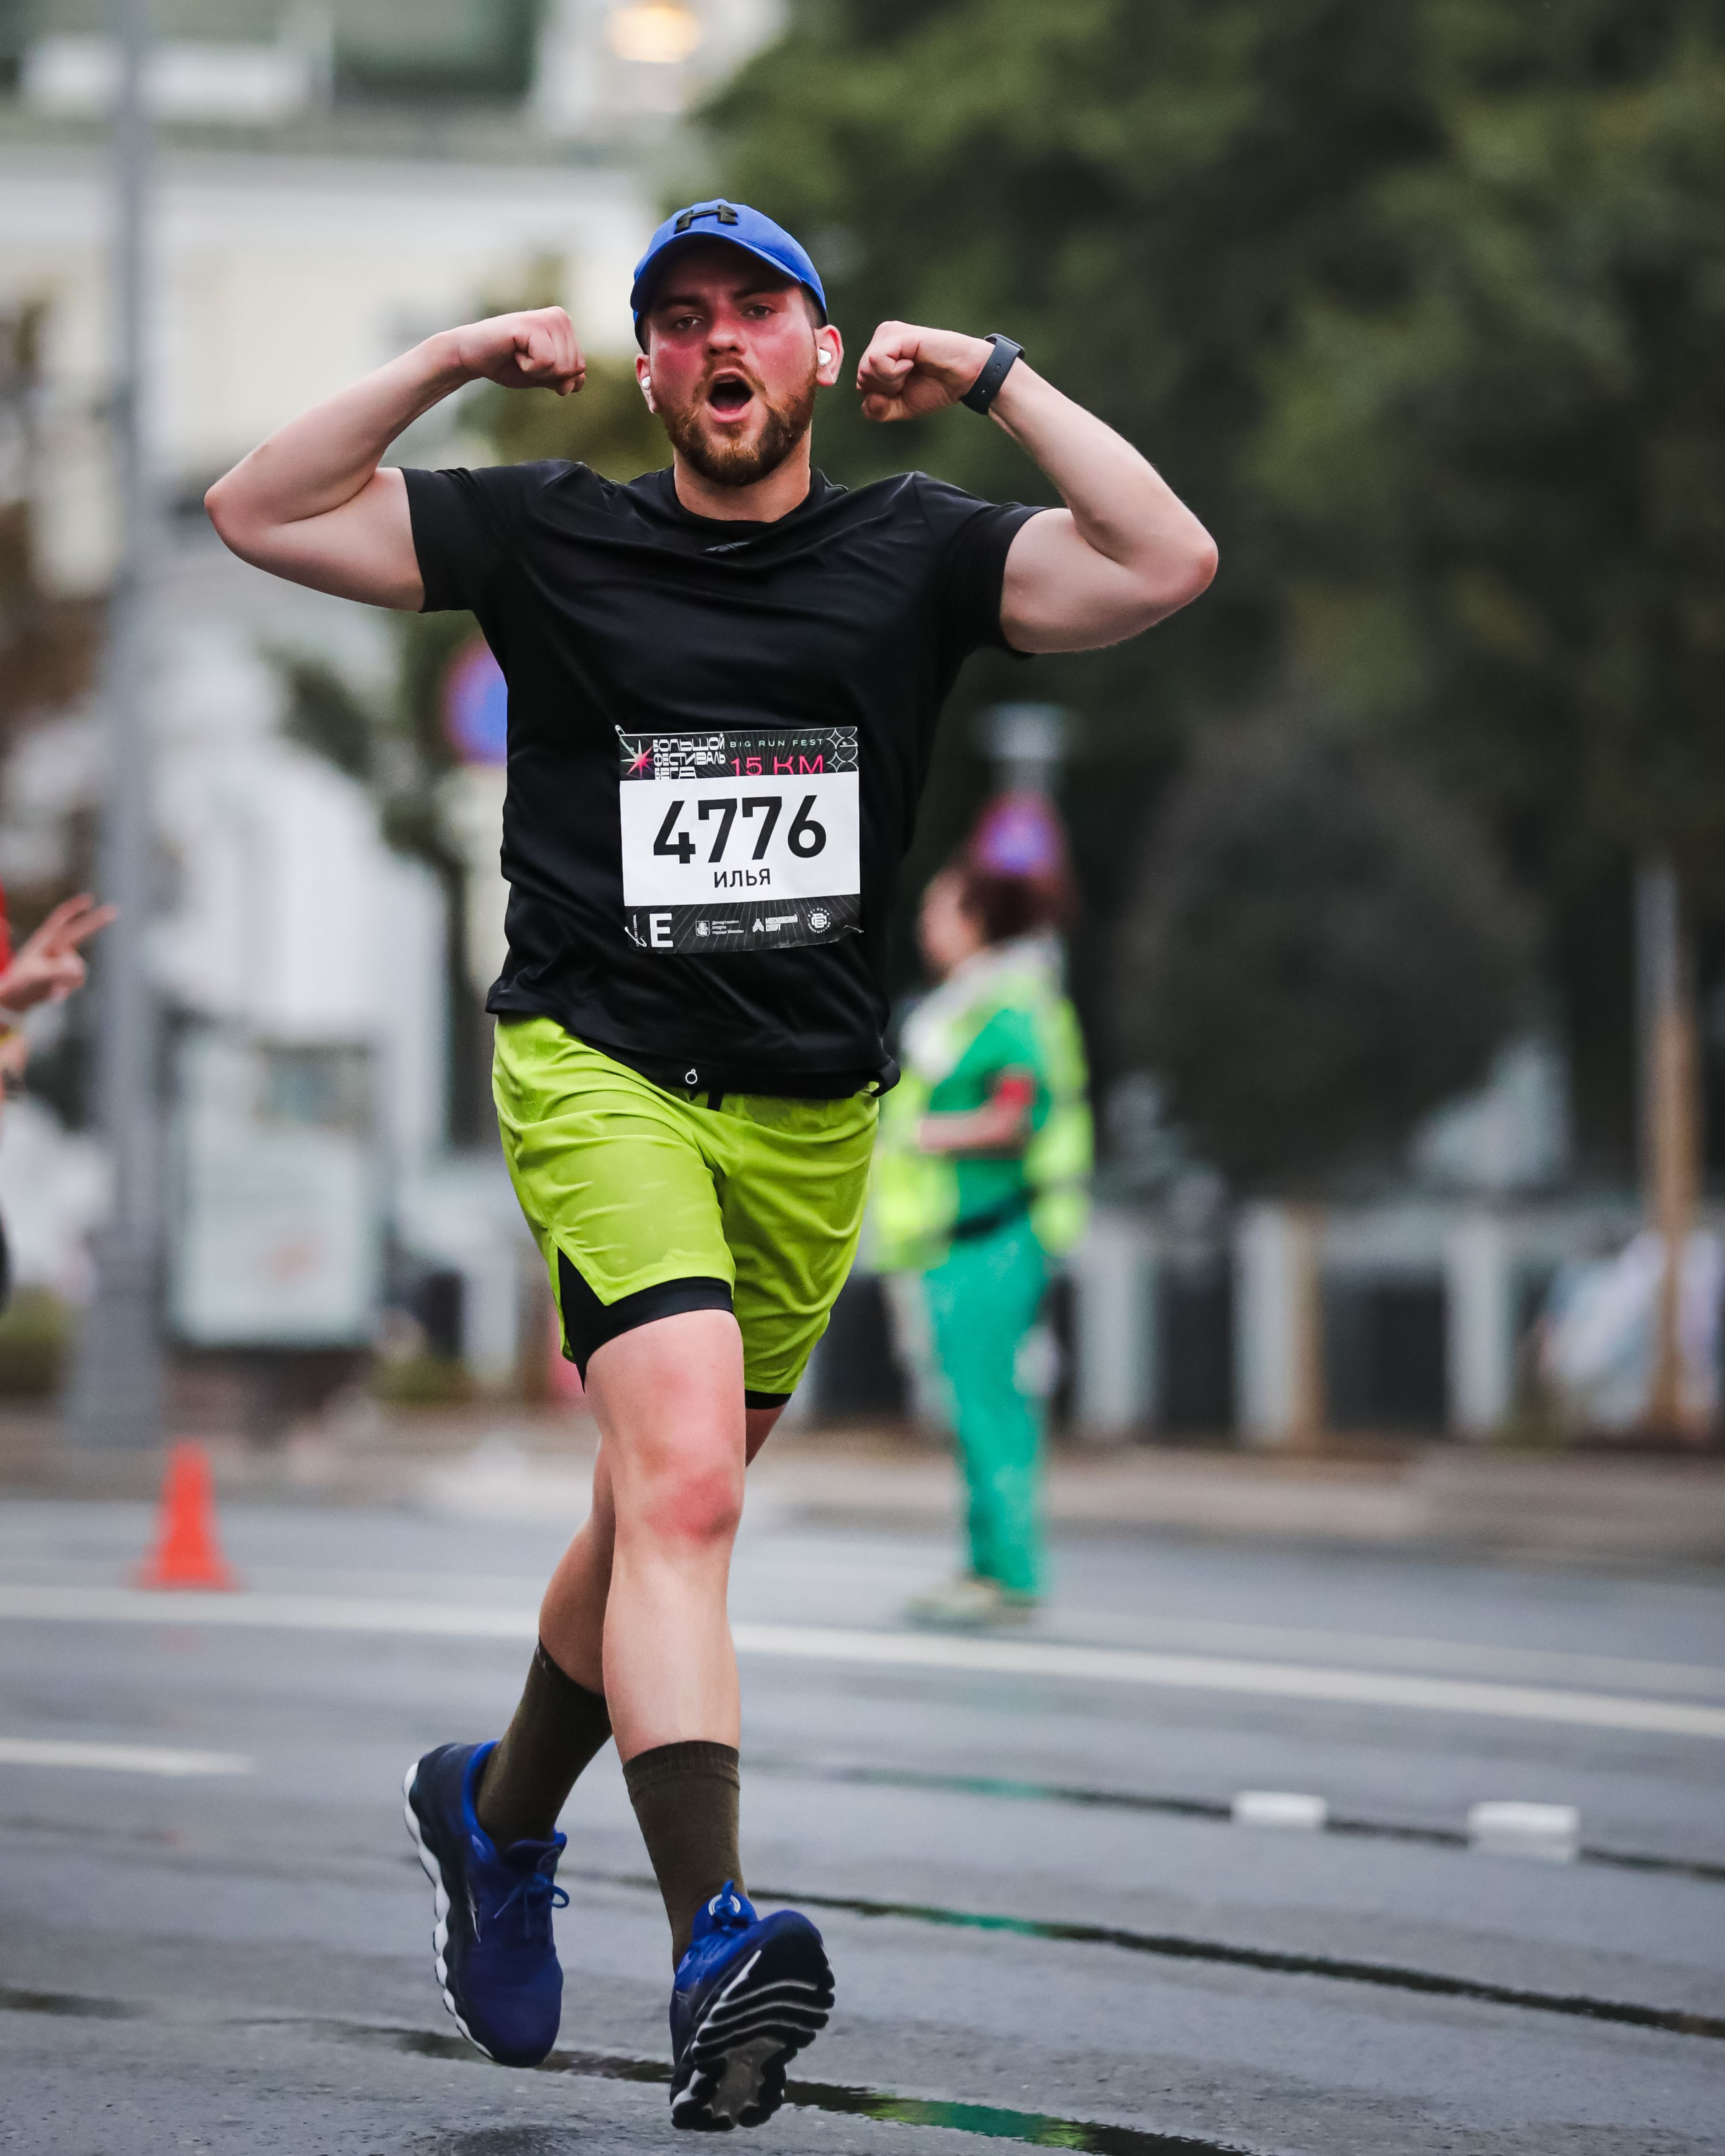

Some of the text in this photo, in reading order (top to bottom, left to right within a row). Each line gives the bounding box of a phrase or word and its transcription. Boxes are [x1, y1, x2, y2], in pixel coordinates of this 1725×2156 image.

[653, 732, 725, 753] БОЛЬШОЙ
[653, 751, 726, 767] ФЕСТИВАЛЬ
[730, 757, 763, 776] 15
[654, 766, 697, 780] БЕГА
[654, 795, 826, 864] 4776
[714, 868, 771, 888] ИЛЬЯ
[650, 913, 673, 947] E
